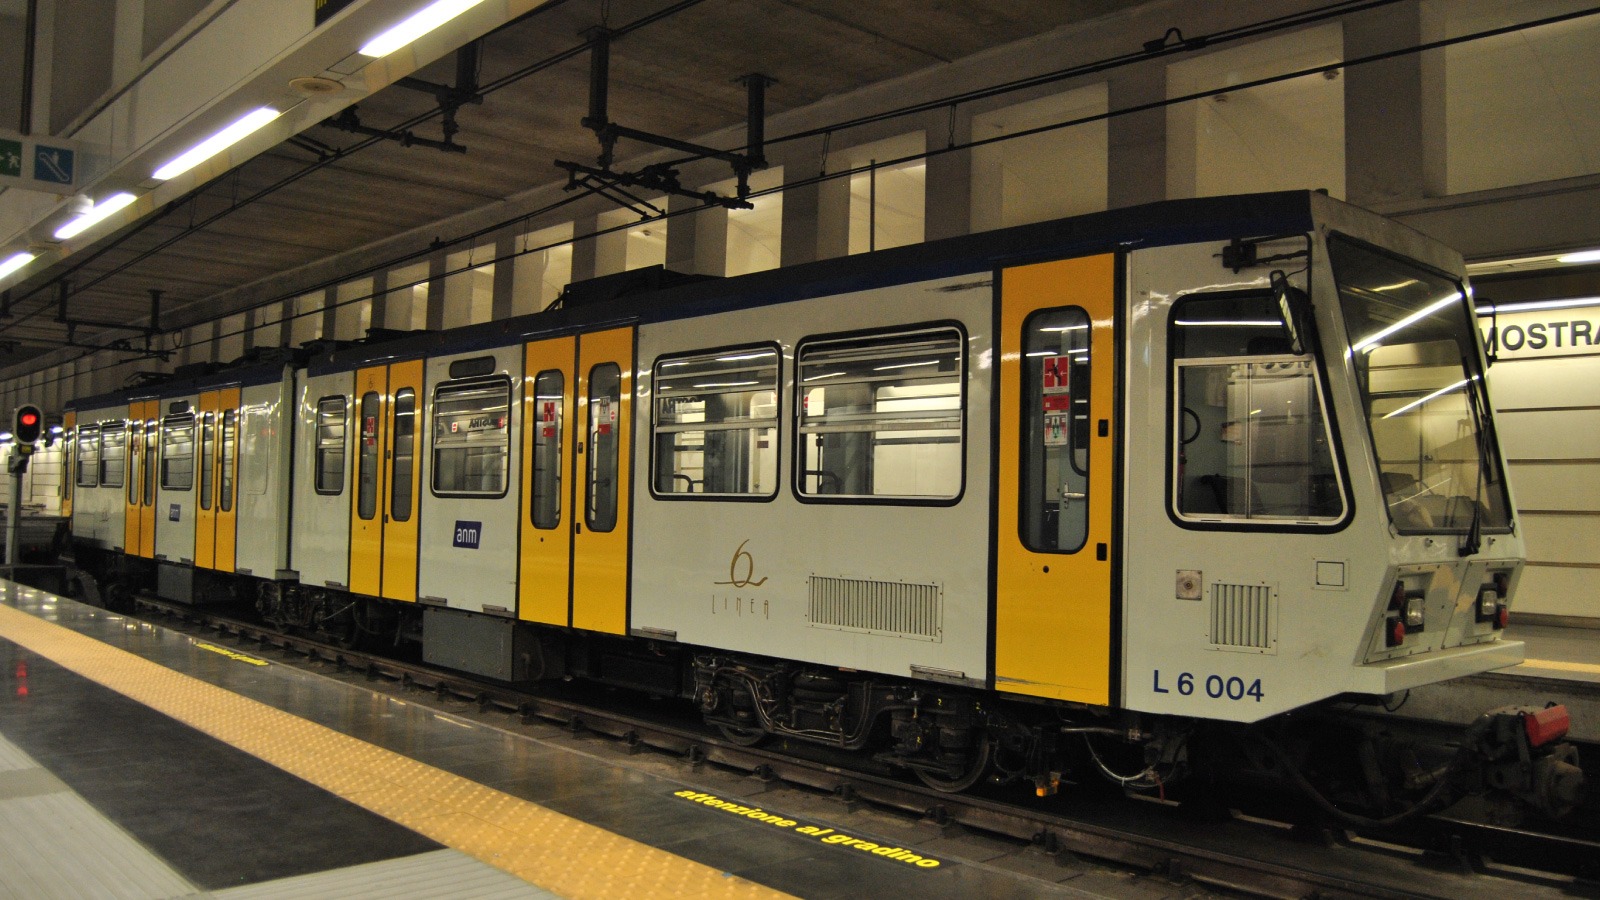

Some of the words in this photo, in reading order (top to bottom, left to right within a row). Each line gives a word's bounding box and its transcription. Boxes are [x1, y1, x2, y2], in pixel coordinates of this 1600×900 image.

[456, 528, 477, 543] anm
[712, 594, 769, 620] LINEA
[1205, 674, 1265, 702] 004
[674, 790, 797, 827] attenzione
[795, 826, 835, 836] al
[821, 834, 940, 868] gradino
